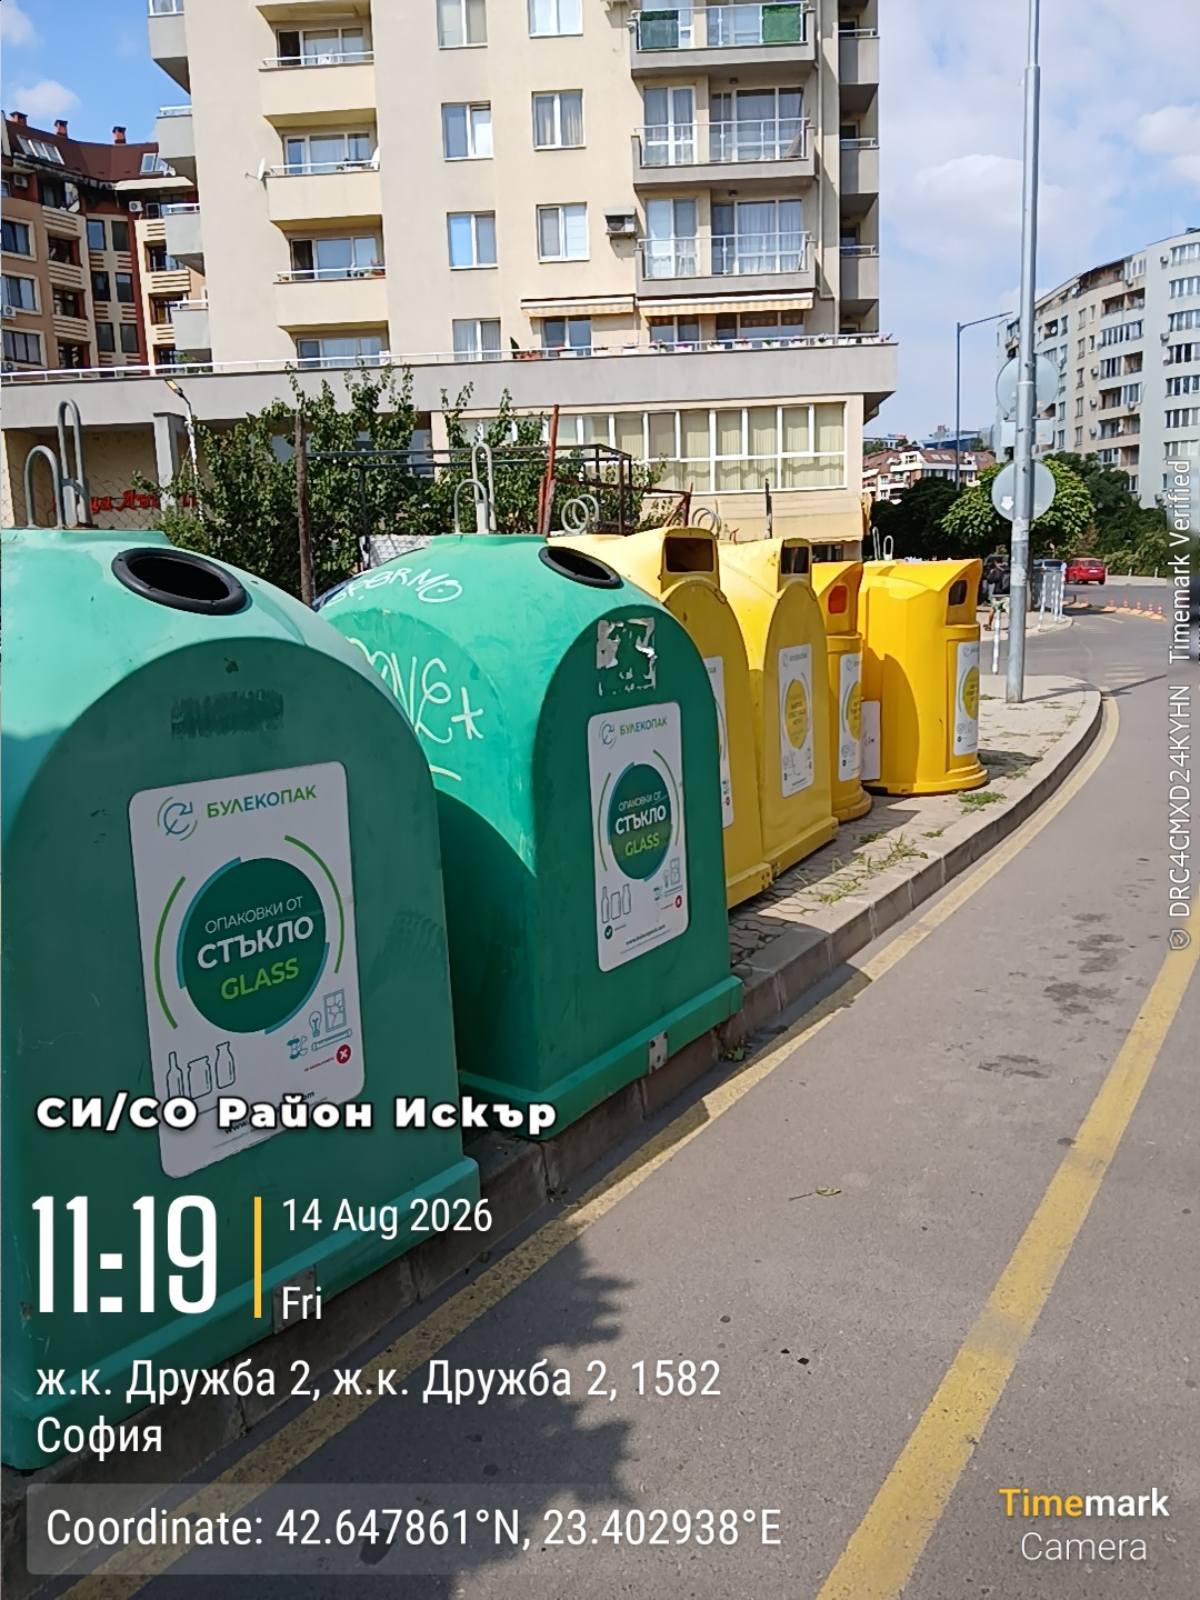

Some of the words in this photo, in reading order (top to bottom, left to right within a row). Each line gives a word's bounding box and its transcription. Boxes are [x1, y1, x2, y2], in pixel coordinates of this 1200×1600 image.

[206, 784, 317, 818] БУЛЕКОПАК
[615, 805, 667, 835] СТЪКЛО
[625, 832, 660, 857] GLASS
[204, 901, 283, 934] ОПАКОВКИ
[286, 896, 303, 911] ОТ
[197, 916, 314, 969] СТЪКЛО
[220, 957, 299, 1000] GLASS
